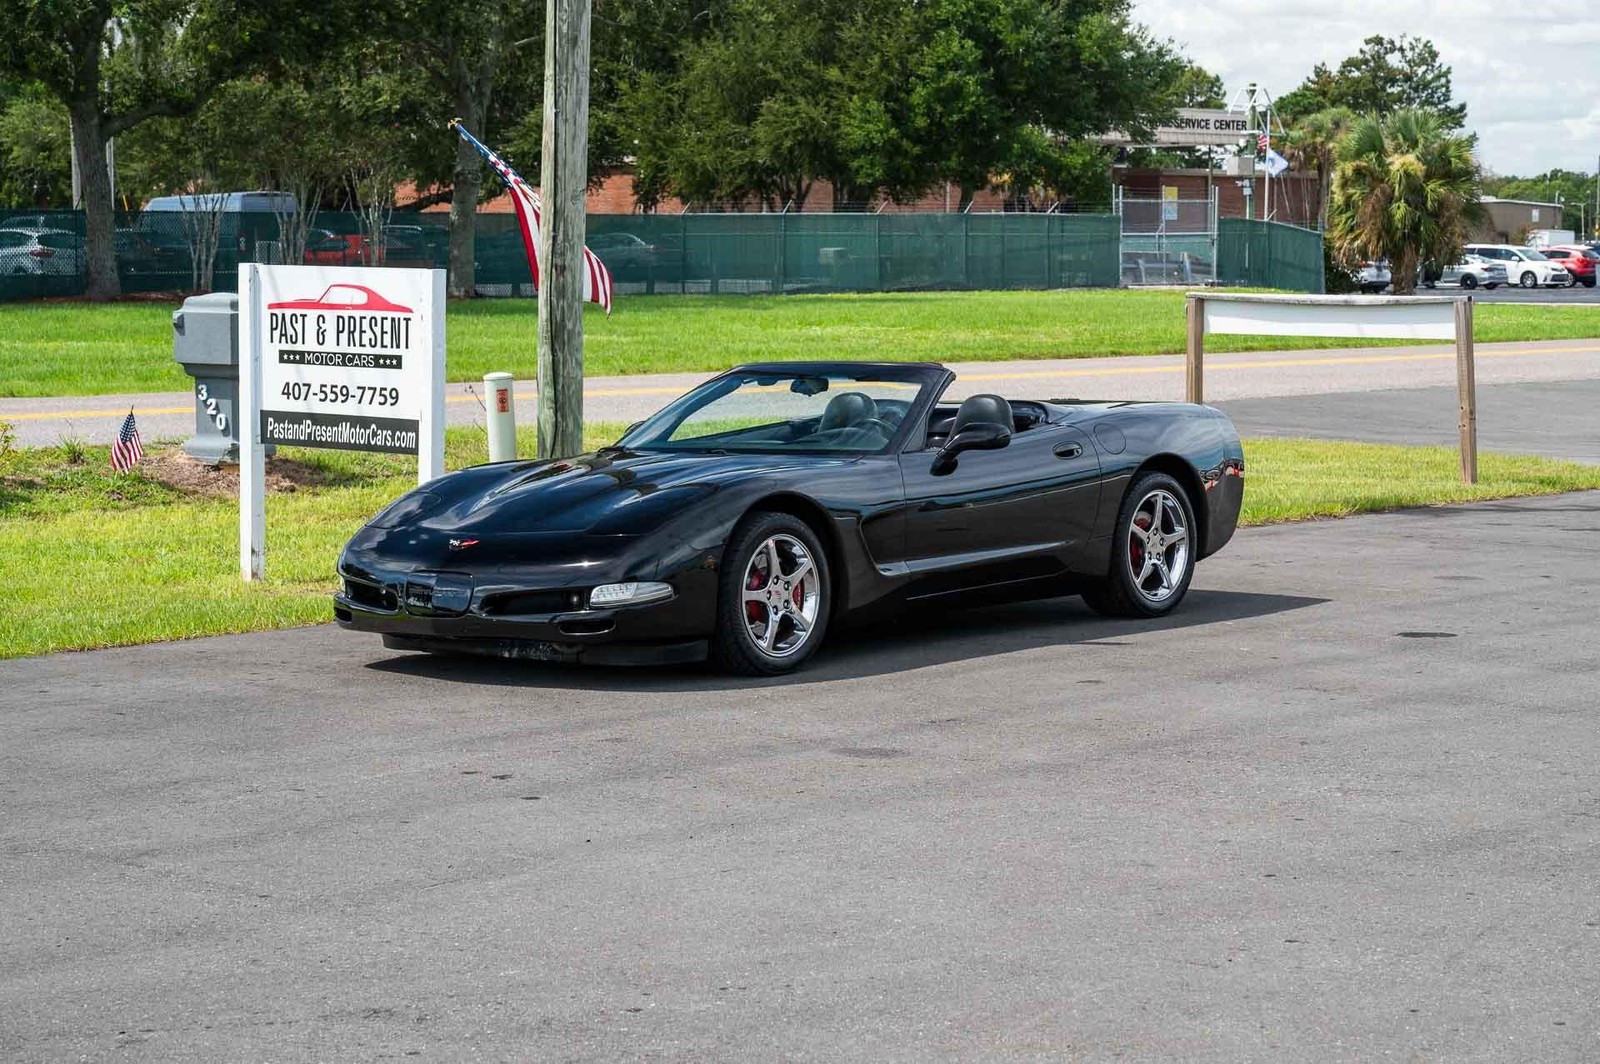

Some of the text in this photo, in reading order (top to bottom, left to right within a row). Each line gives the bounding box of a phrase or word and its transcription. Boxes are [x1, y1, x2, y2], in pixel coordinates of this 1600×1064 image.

[1174, 118, 1211, 130] SERVICE
[1213, 119, 1247, 131] CENTER
[270, 313, 412, 349] PAST & PRESENT
[304, 352, 375, 367] MOTOR CARS
[198, 384, 226, 430] 320
[281, 382, 399, 406] 407-559-7759
[267, 417, 416, 449] PastandPresentMotorCars.com
